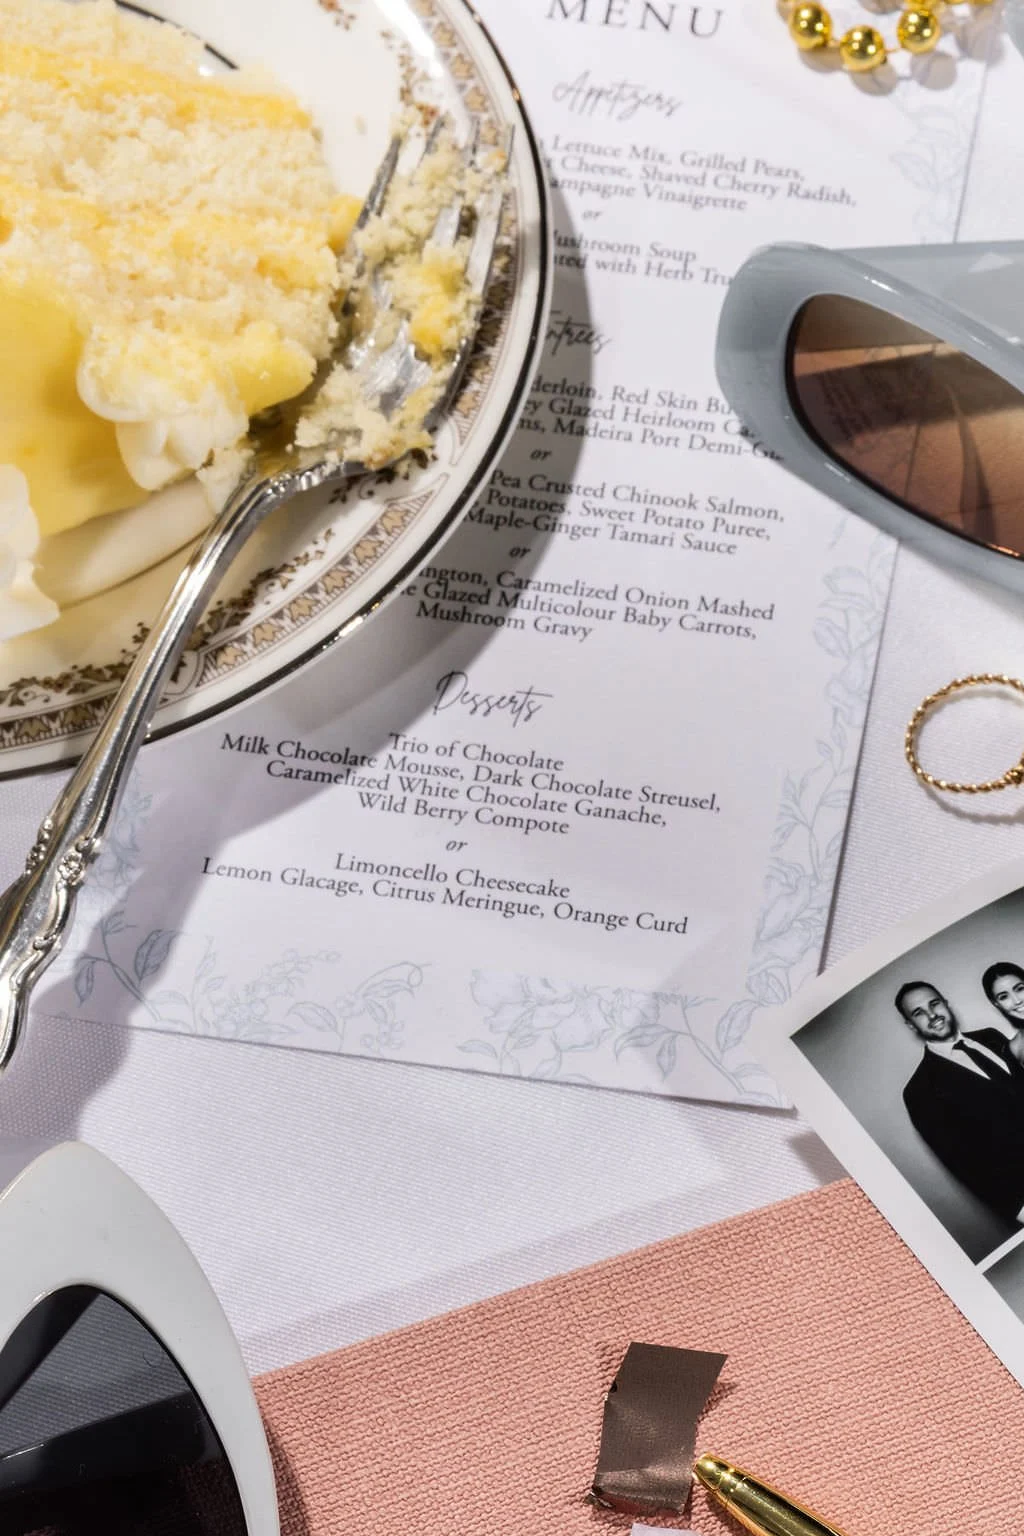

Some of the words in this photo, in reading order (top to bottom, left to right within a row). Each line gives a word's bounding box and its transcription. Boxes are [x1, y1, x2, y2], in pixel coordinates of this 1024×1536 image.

[546, 0, 723, 38] MENU
[552, 69, 683, 121] Appetizers
[552, 134, 622, 158] Lettuce
[680, 149, 747, 173] Grilled
[754, 158, 805, 182] Pears,
[550, 177, 636, 199] ampagne
[643, 182, 748, 211] Vinaigrette
[640, 164, 706, 187] Shaved
[713, 172, 779, 200] Cherry
[582, 210, 602, 220] or
[553, 229, 640, 256] ushroom
[649, 241, 697, 266] Soup
[595, 256, 637, 275] with
[644, 260, 694, 281] Herb
[548, 397, 616, 420] Glazed
[622, 405, 715, 432] Heirloom
[612, 385, 649, 405] Red
[655, 390, 698, 410] Skin
[553, 417, 632, 442] Madeira
[641, 427, 680, 448] Port
[530, 449, 551, 460] or
[487, 488, 572, 515] Potatoes,
[579, 500, 634, 522] Sweet
[643, 508, 704, 531] Potato
[712, 516, 771, 541] Puree,
[489, 469, 521, 488] Pea
[529, 474, 605, 498] Crusted
[612, 484, 699, 511] Chinook
[705, 496, 785, 522] Salmon,
[464, 507, 601, 541] Maple-Ginger
[608, 523, 674, 547] Tamari
[681, 532, 738, 555] Sauce
[509, 547, 531, 559] or
[423, 582, 491, 606] Glazed
[497, 591, 616, 621] Multicolour
[623, 606, 672, 632] Baby
[679, 614, 756, 640] Carrots,
[496, 570, 618, 601] Caramelized
[625, 586, 689, 611] Onion
[697, 595, 775, 621] Mashed
[416, 600, 525, 630] Mushroom
[533, 615, 593, 643] Gravy
[432, 671, 554, 728] Desserts
[220, 732, 270, 755] Milk
[276, 739, 378, 768] Chocolate
[383, 753, 465, 781] Mousse,
[473, 764, 524, 788] Dark
[531, 772, 633, 801] Chocolate
[638, 785, 721, 813] Streusel,
[388, 732, 429, 754] Trio
[435, 740, 460, 757] of
[463, 743, 565, 772] Chocolate
[266, 759, 390, 791] Caramelized
[398, 775, 460, 800] White
[466, 784, 568, 813] Chocolate
[574, 798, 667, 827] Ganache,
[358, 791, 407, 814] Wild
[414, 799, 468, 826] Berry
[475, 806, 570, 835] Compote
[446, 840, 468, 852] or
[200, 856, 272, 883] Lemon
[280, 867, 364, 897] Glacage,
[373, 879, 435, 903] Citrus
[441, 887, 545, 919] Meringue,
[553, 902, 629, 931] Orange
[635, 912, 688, 935] Curd
[334, 852, 448, 883] Limoncello
[455, 868, 570, 899] Cheesecake
